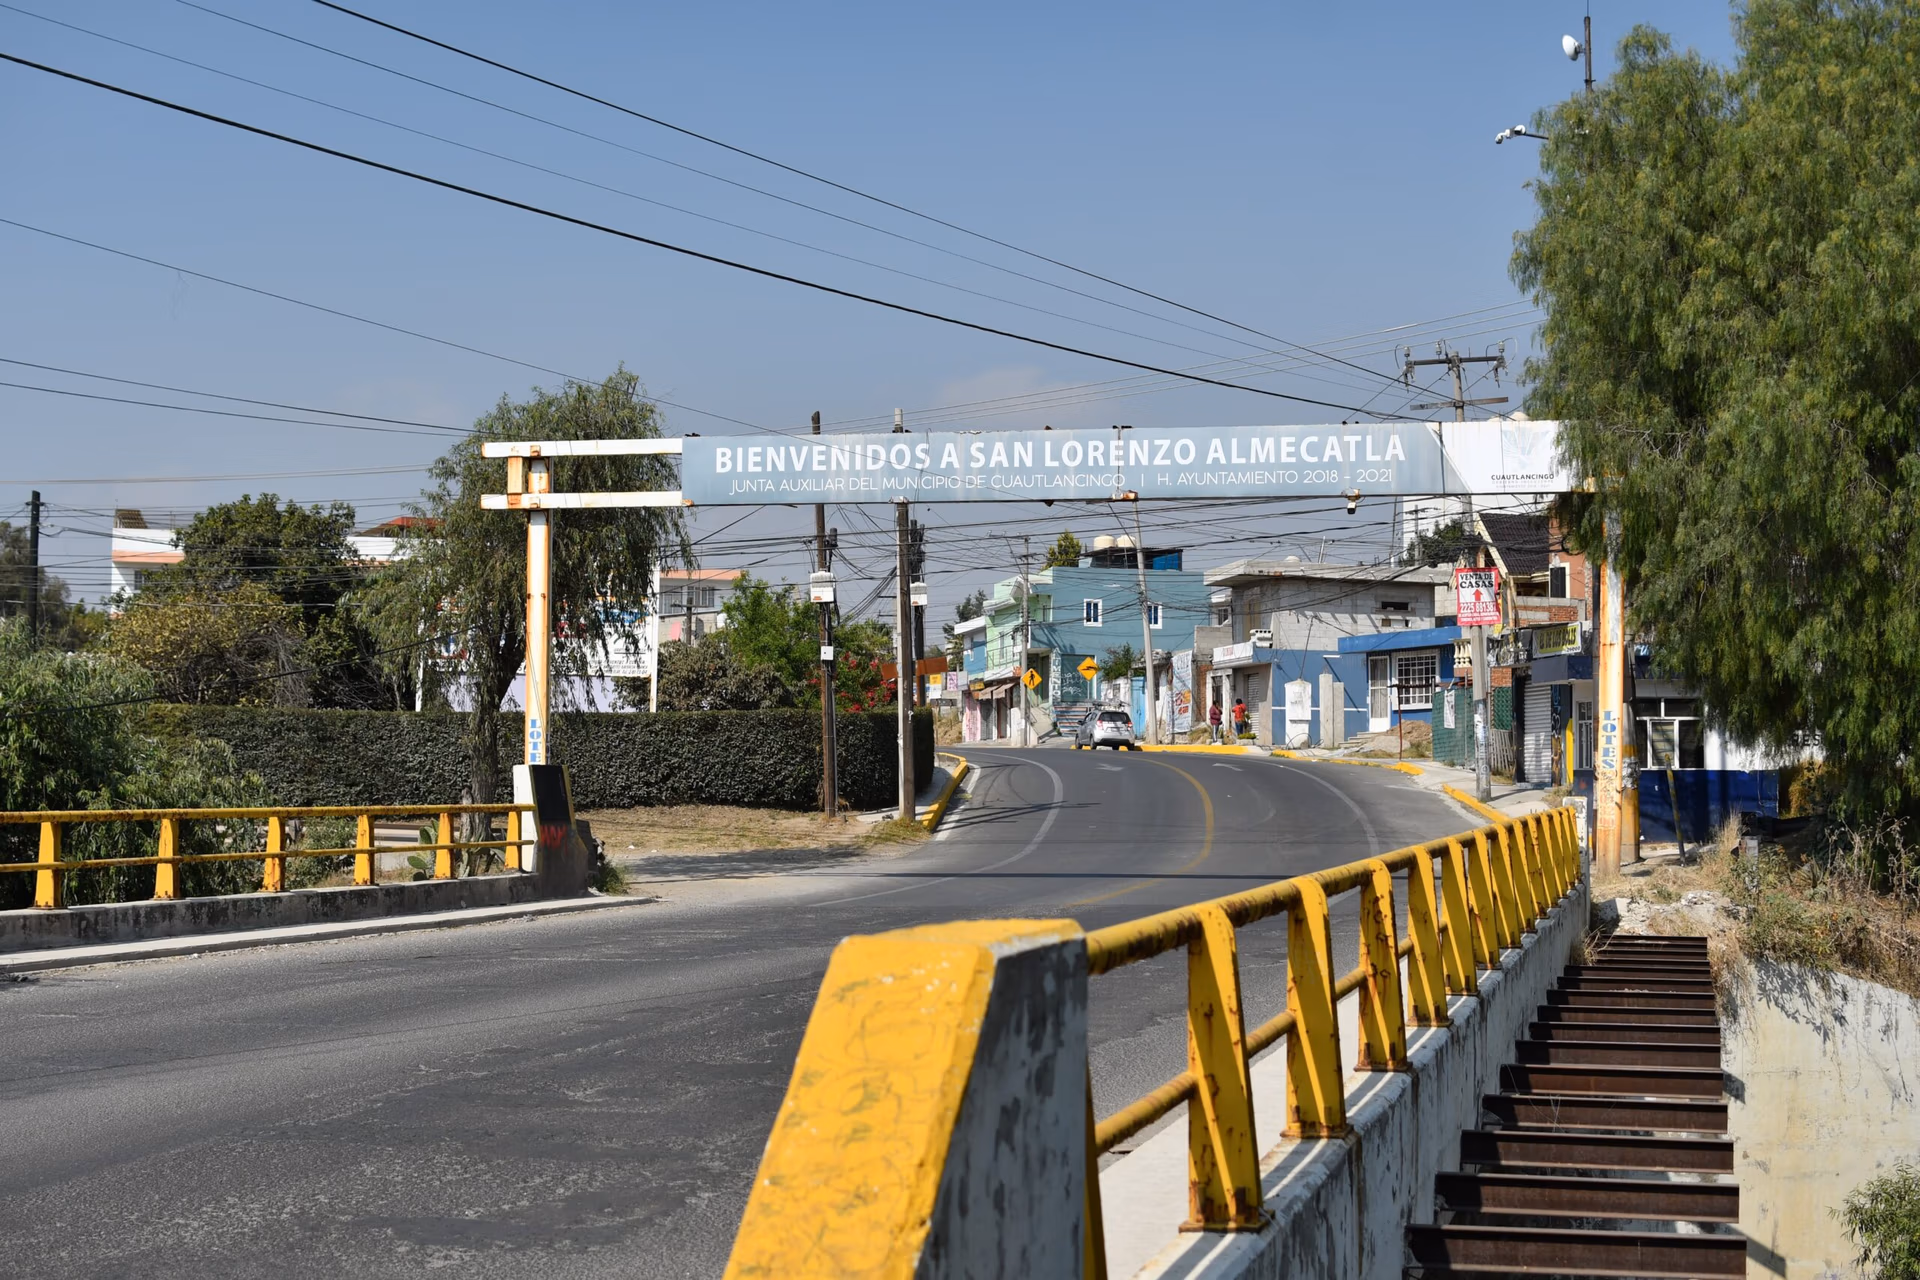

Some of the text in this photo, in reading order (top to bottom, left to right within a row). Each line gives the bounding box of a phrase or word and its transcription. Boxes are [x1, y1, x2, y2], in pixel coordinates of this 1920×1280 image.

[715, 434, 1406, 474] BIENVENIDOS A SAN LORENZO ALMECATLA
[728, 478, 776, 496] JUNTA
[779, 477, 846, 493] AUXILIAR
[848, 477, 879, 491] DEL
[882, 474, 962, 491] MUNICIPIO
[965, 474, 988, 488] DE
[990, 473, 1126, 489] CUAUTLANCINGO
[1157, 472, 1173, 486] H.
[1176, 470, 1299, 486] AYUNTAMIENTO
[1303, 469, 1339, 484] 2018
[1356, 468, 1394, 483] 2021
[1490, 473, 1555, 481] CUAUTLANCINGO
[1459, 572, 1494, 581] VENTA DE
[1459, 580, 1494, 589] CASAS
[1601, 709, 1617, 770] LOTES
